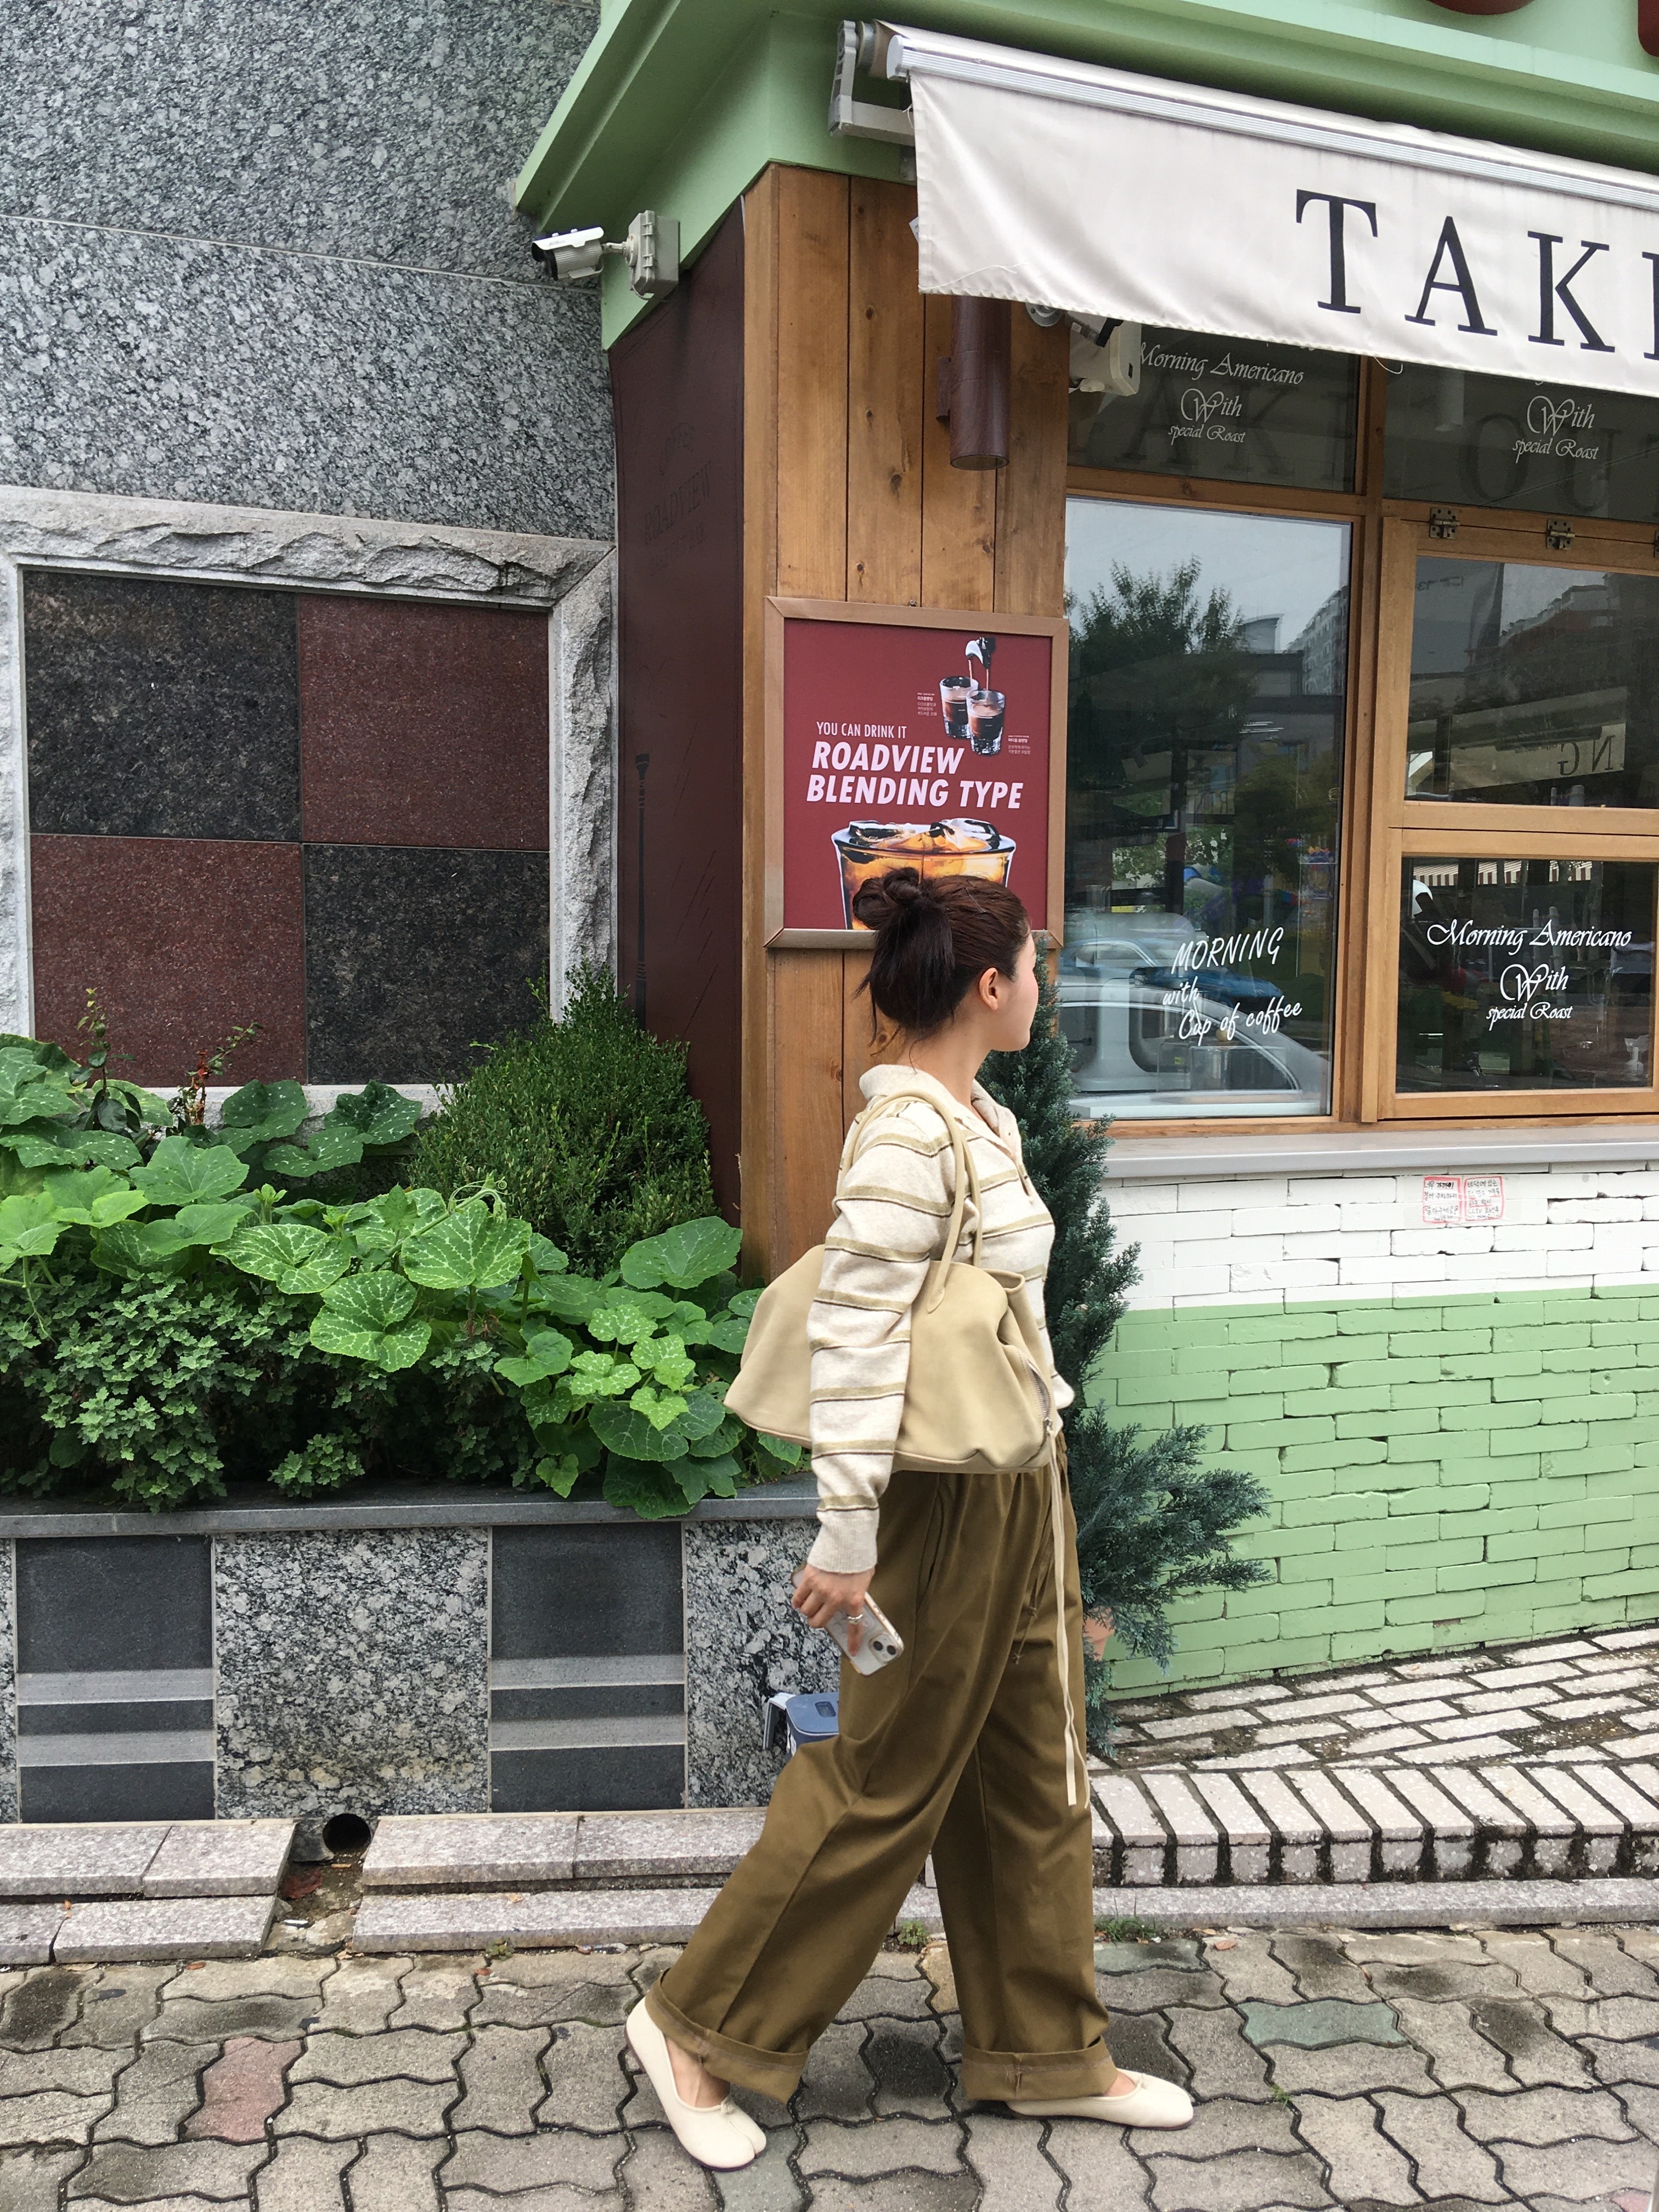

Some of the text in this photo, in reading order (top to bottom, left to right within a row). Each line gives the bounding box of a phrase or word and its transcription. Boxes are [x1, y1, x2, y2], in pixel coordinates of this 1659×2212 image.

[1210, 353, 1304, 385] Americano
[1181, 388, 1243, 422] With
[1527, 395, 1595, 436] With
[1169, 424, 1246, 445] special Roast
[1512, 438, 1599, 464] special Roast
[816, 721, 907, 739] YOU CAN DRINK IT
[812, 741, 965, 774] ROADVIEW
[806, 774, 1024, 809] BLENDING TYPE
[1171, 927, 1284, 974] MORNING
[1427, 919, 1632, 956] Morning Americano
[1163, 976, 1199, 1005] with
[1500, 963, 1569, 1002] With
[1178, 995, 1302, 1046] Cup of coffee
[1486, 1002, 1573, 1031] special Roast
